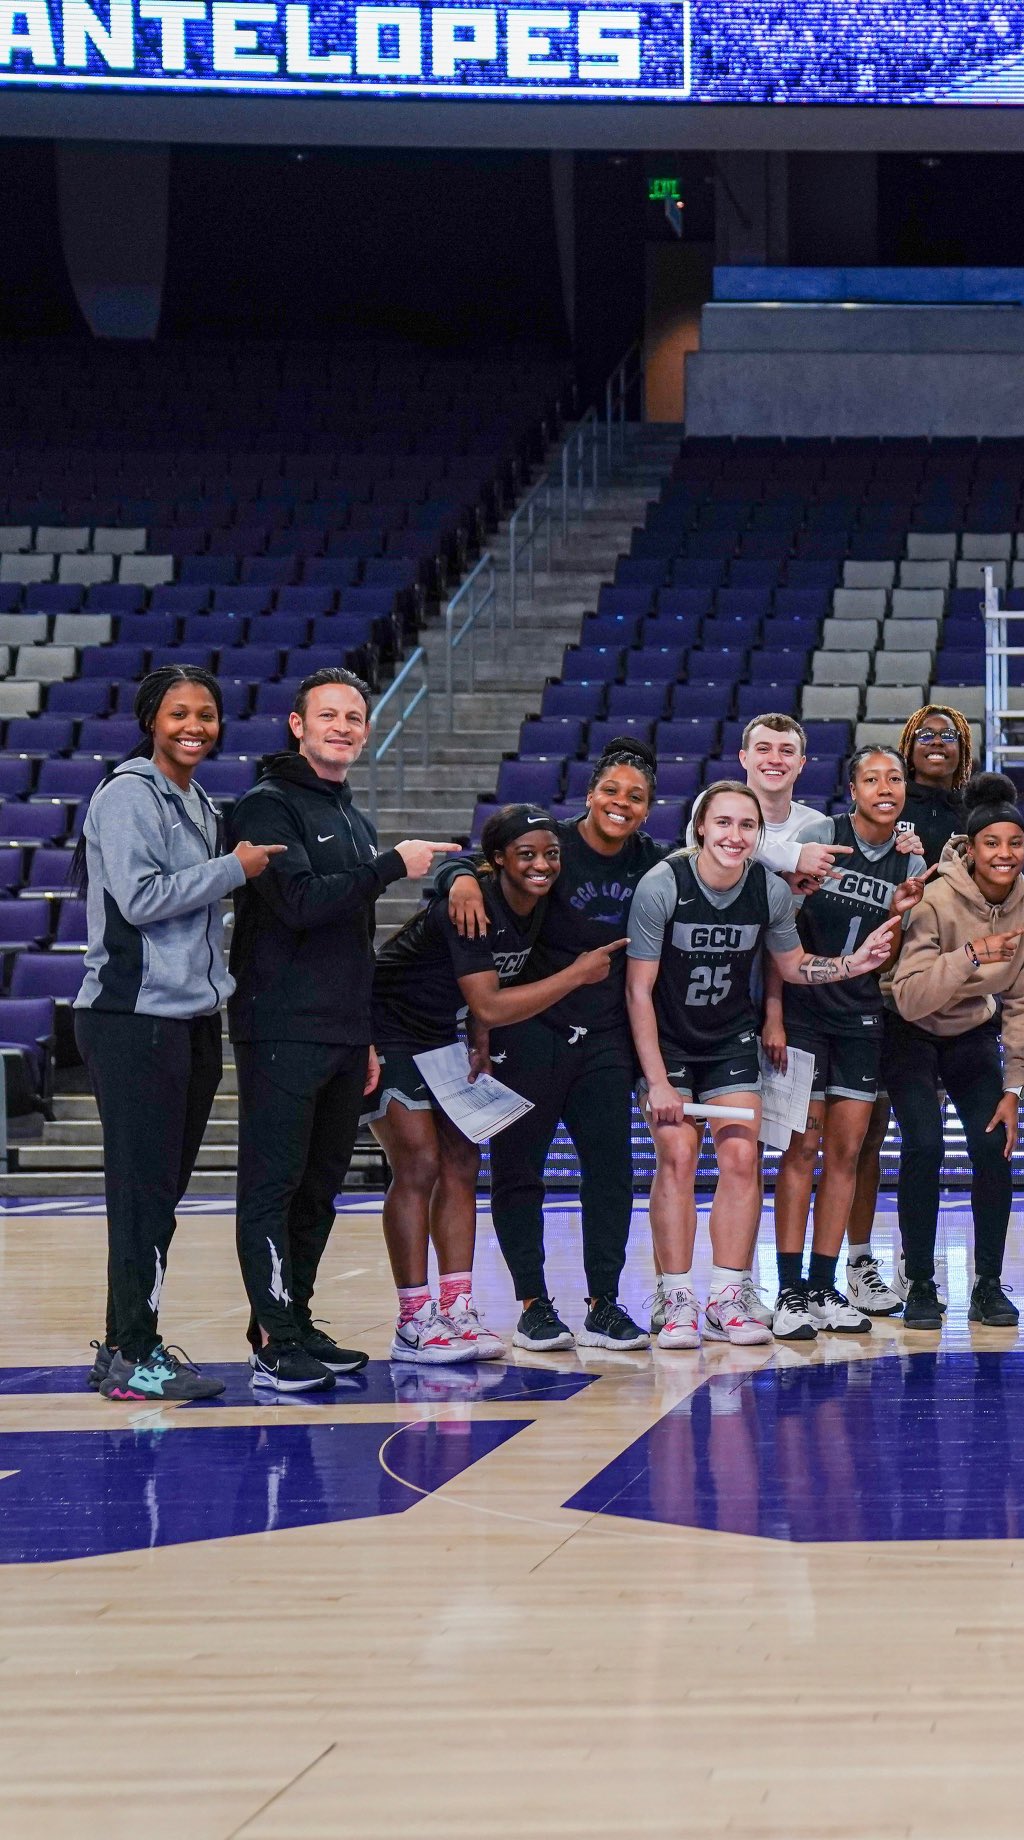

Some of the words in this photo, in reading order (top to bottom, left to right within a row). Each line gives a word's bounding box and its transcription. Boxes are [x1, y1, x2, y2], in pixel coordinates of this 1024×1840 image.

[0, 0, 640, 79] ANTELOPES
[570, 881, 599, 910] GCU
[602, 881, 633, 902] LOP
[838, 873, 888, 905] GCU
[690, 926, 742, 949] GCU
[839, 915, 863, 956] 1
[684, 963, 732, 1006] 25
